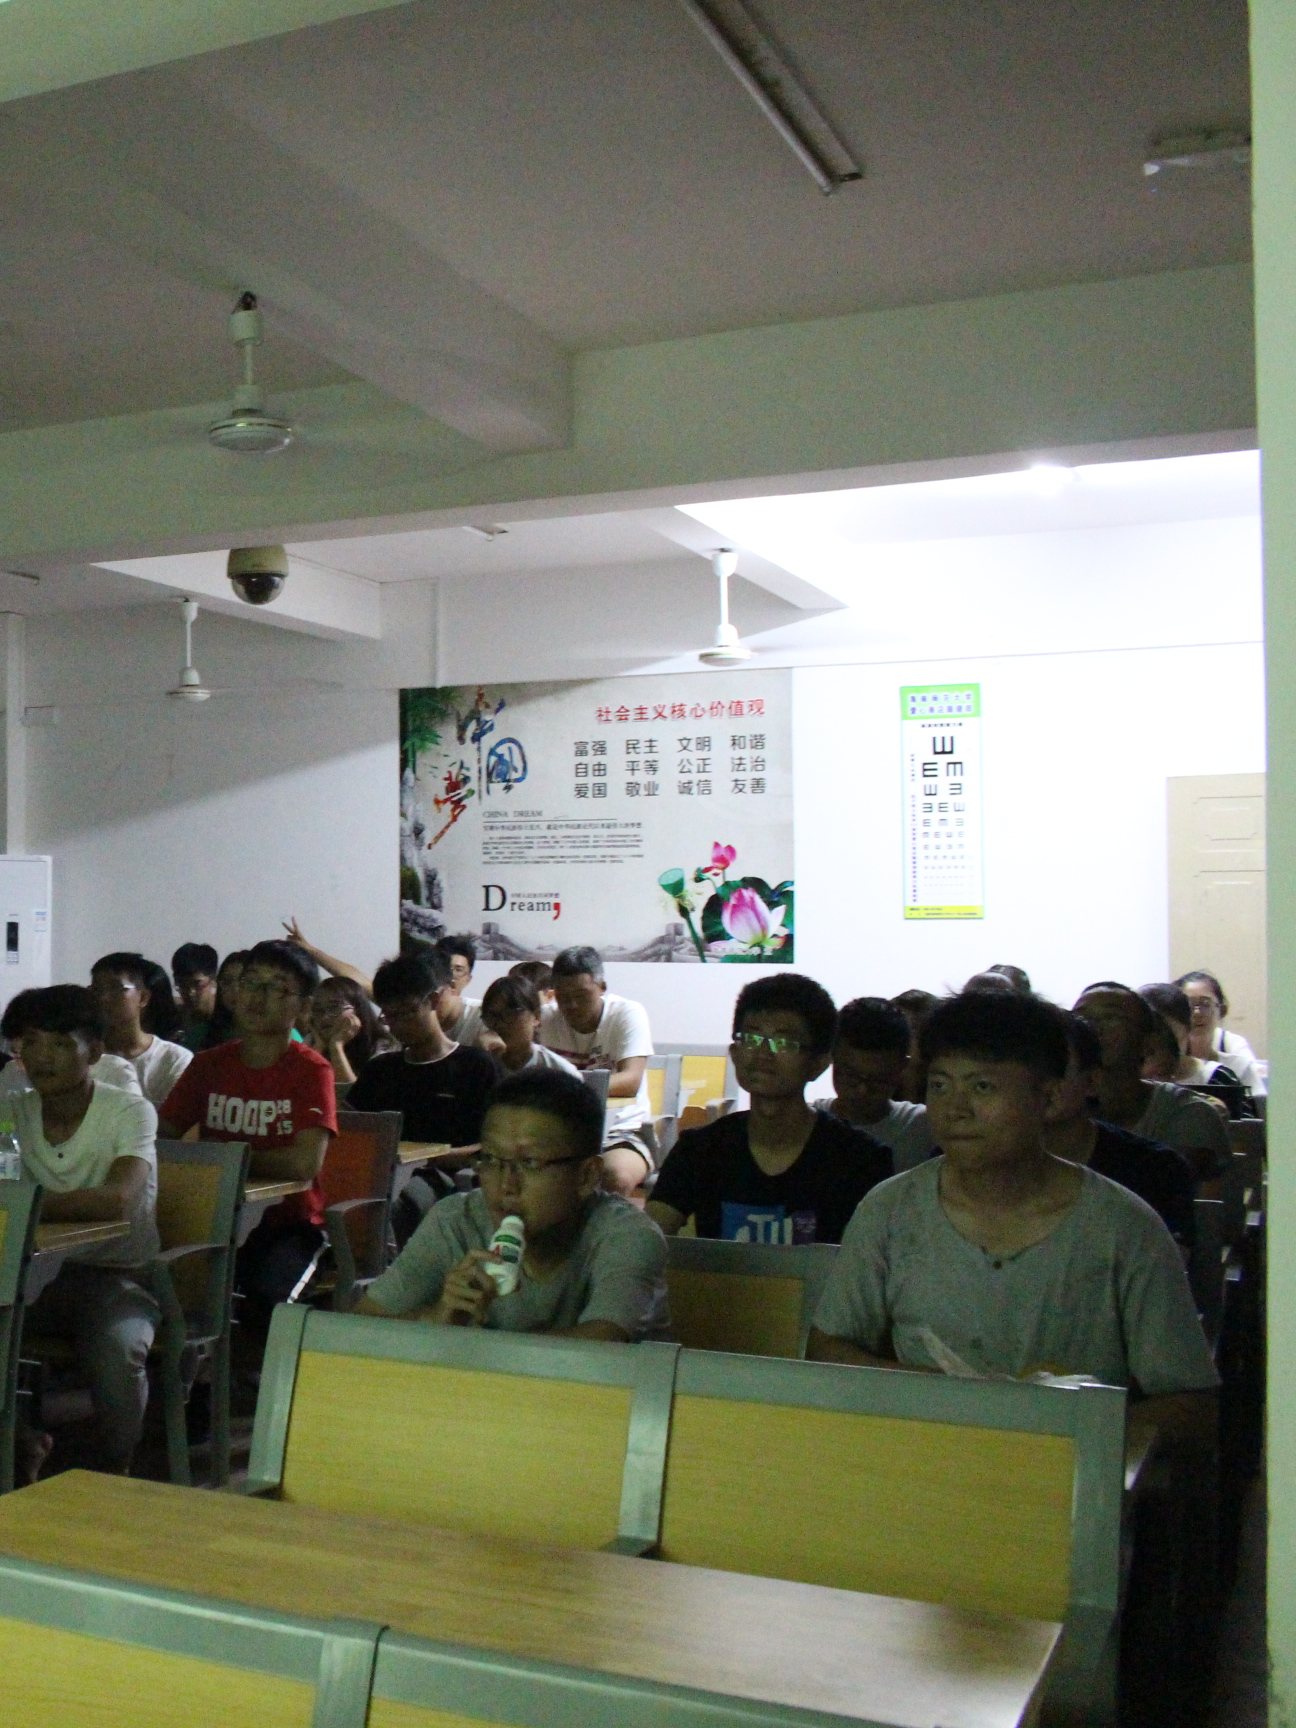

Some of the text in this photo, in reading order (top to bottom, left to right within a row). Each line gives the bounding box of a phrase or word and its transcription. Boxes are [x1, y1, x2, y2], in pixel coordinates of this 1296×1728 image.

[596, 699, 766, 723] 社会主义核心价值观
[573, 733, 766, 757] 富强 民主 文明 和谐
[574, 756, 766, 778] 自由 平等 公正 法治
[573, 778, 766, 799] 爱国 敬业 诚信 友善
[206, 1092, 277, 1136] HOOP
[276, 1120, 293, 1135] 15
